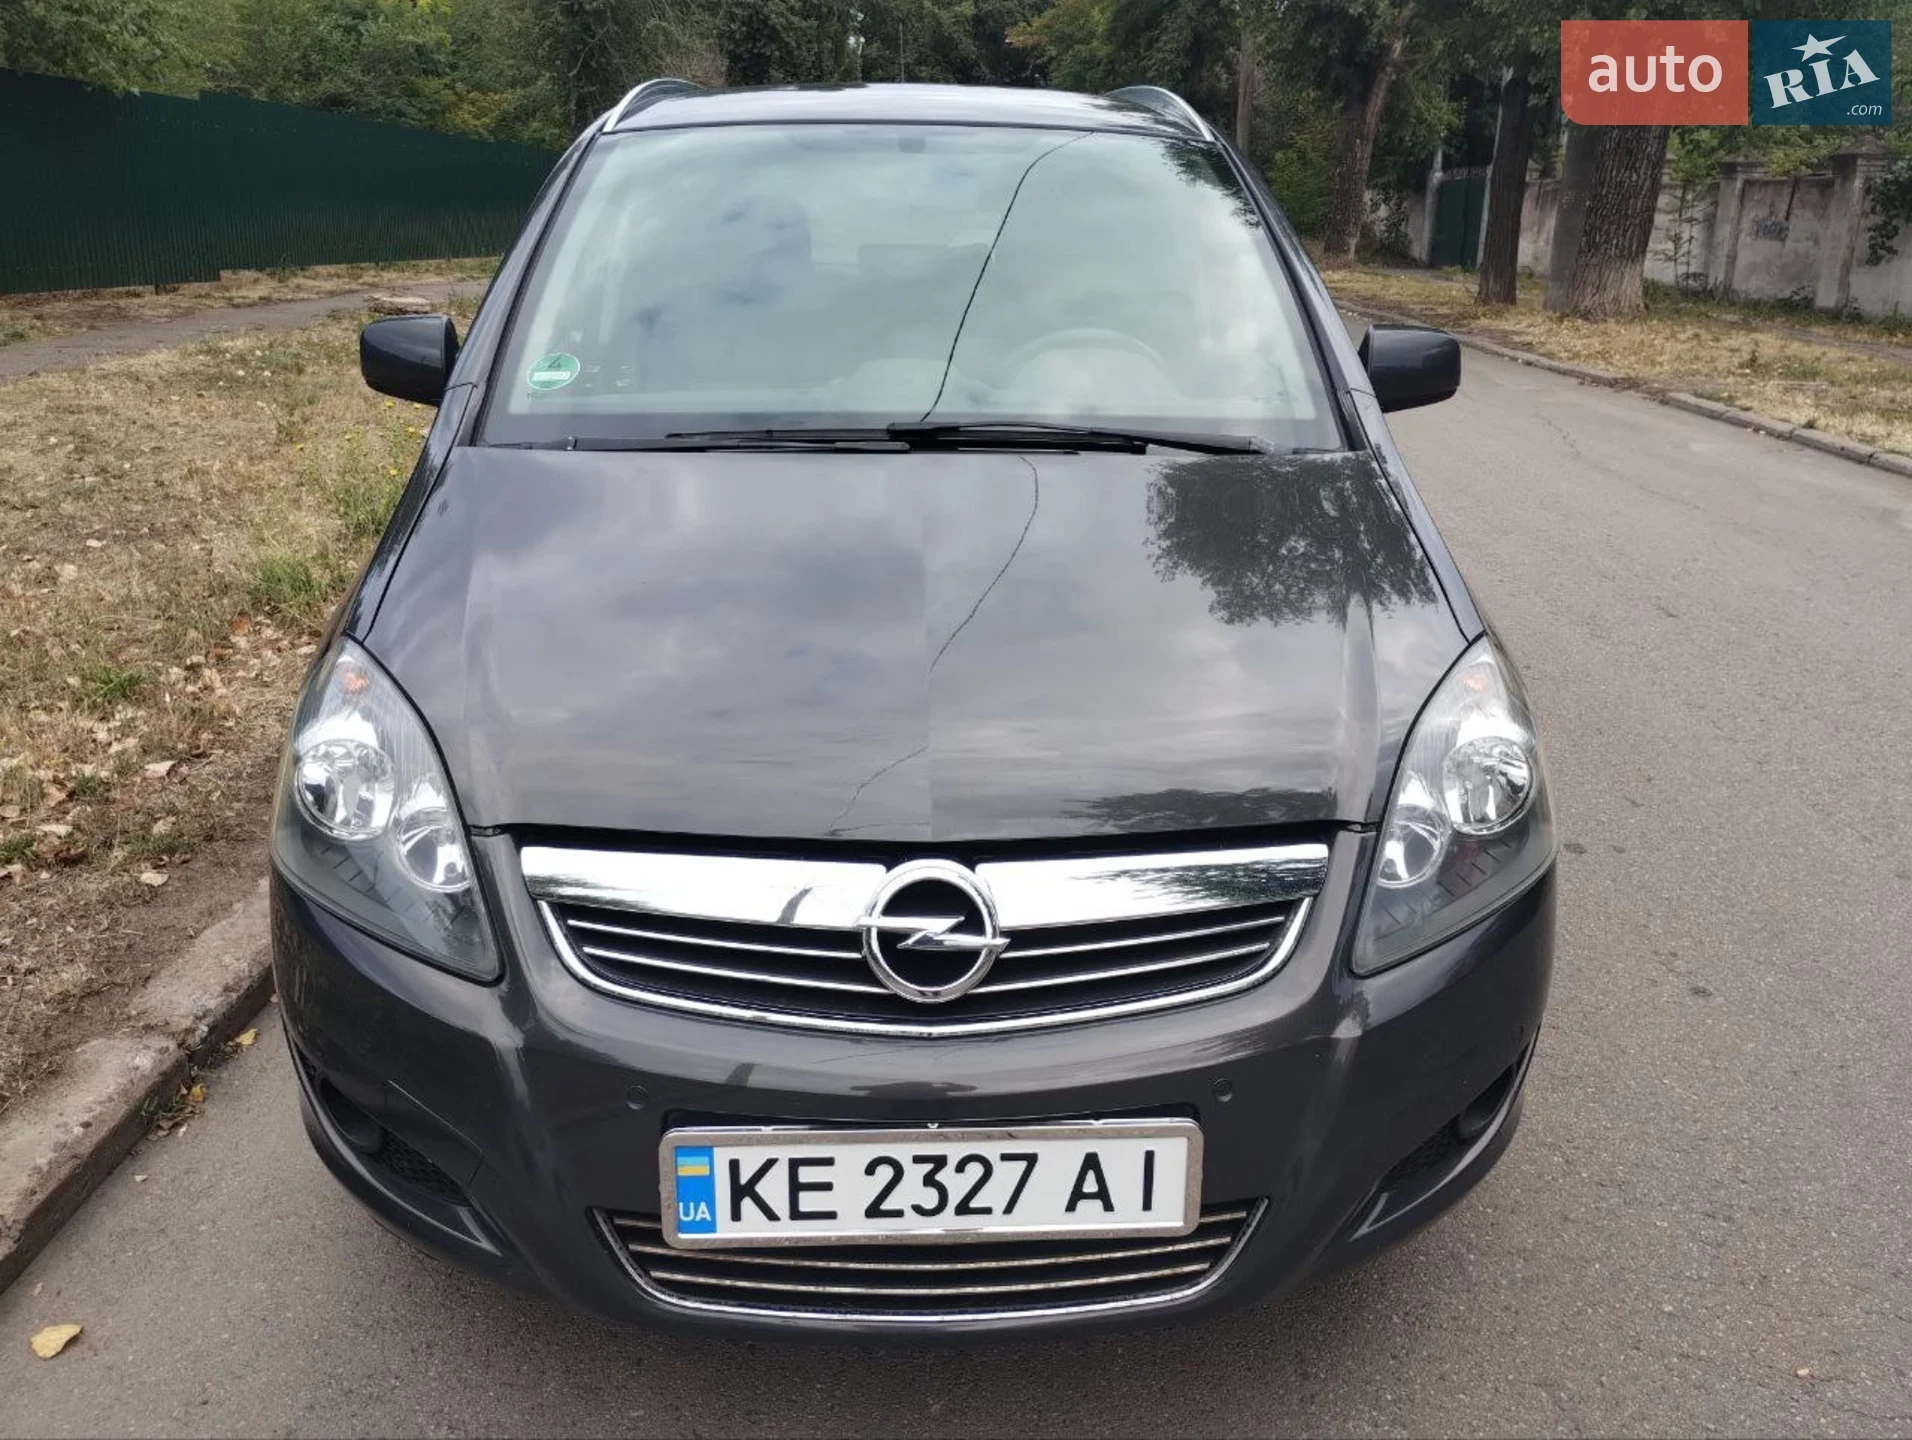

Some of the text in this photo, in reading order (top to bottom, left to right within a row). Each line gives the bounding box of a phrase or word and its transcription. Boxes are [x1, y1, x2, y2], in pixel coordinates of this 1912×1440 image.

[728, 1156, 838, 1222] KE
[864, 1152, 1039, 1219] 2327
[679, 1202, 712, 1222] UA
